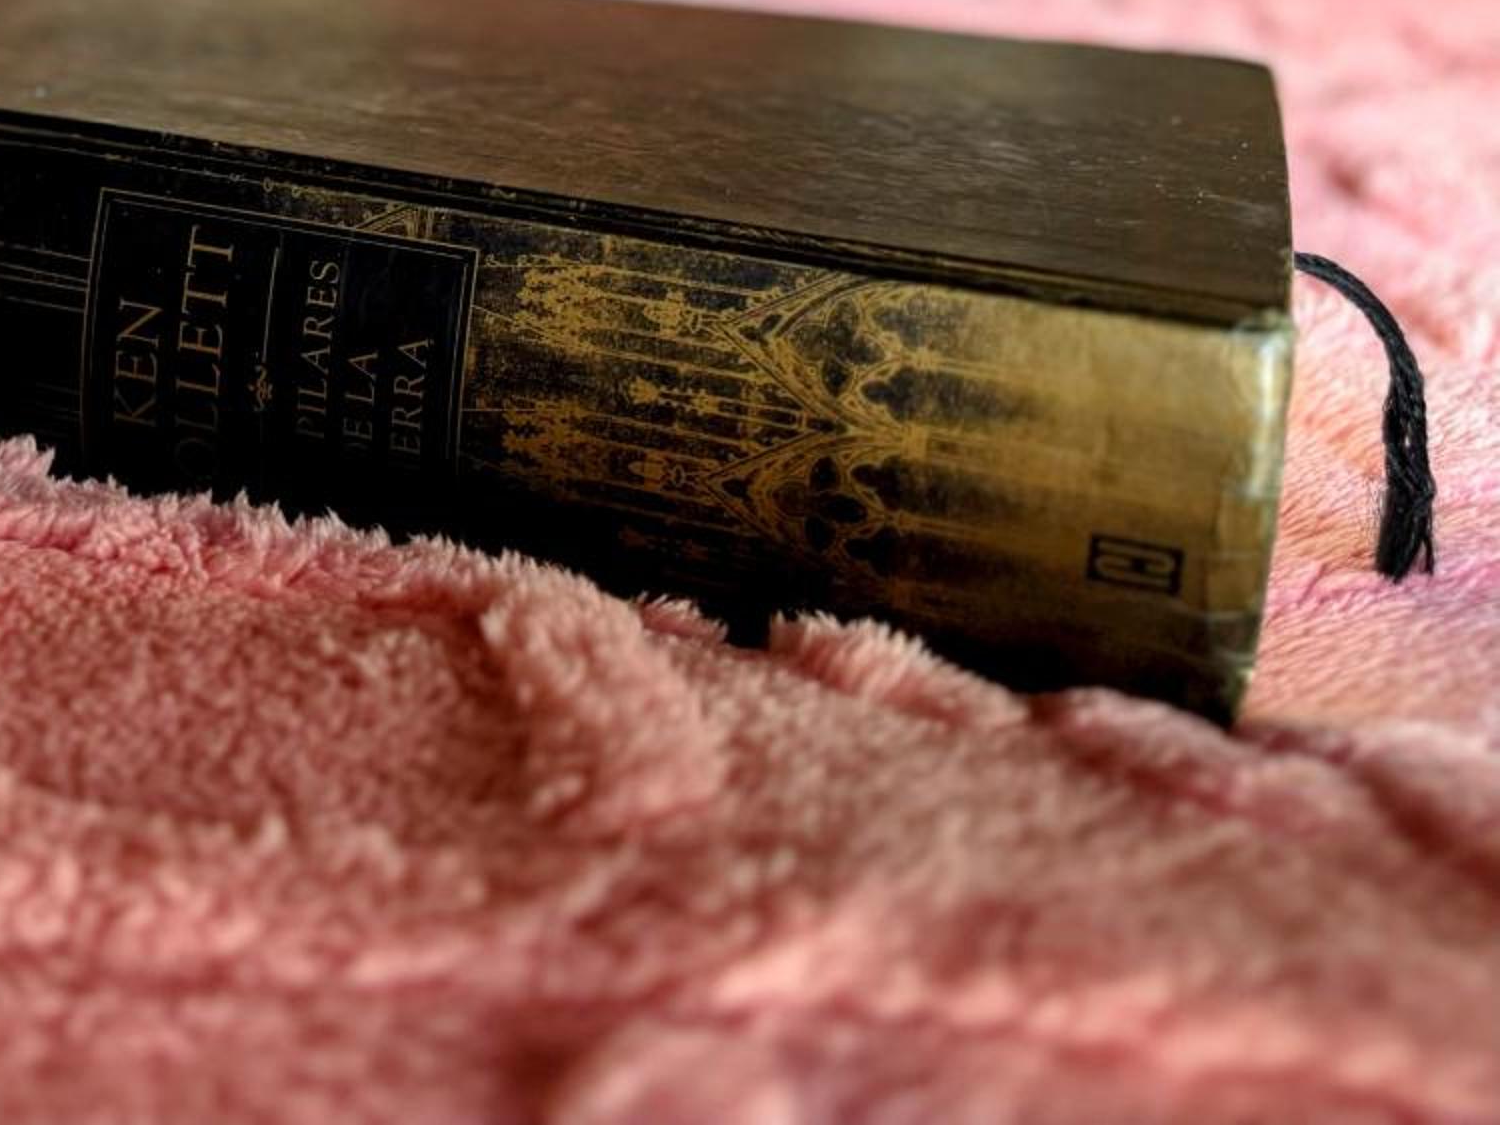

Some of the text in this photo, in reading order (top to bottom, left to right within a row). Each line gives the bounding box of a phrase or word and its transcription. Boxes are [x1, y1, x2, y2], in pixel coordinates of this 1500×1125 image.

[113, 298, 165, 427] KEN
[174, 223, 234, 479] OLLETT
[295, 259, 342, 439] PILARES
[344, 352, 379, 409] LA
[390, 337, 431, 469] ERRA
